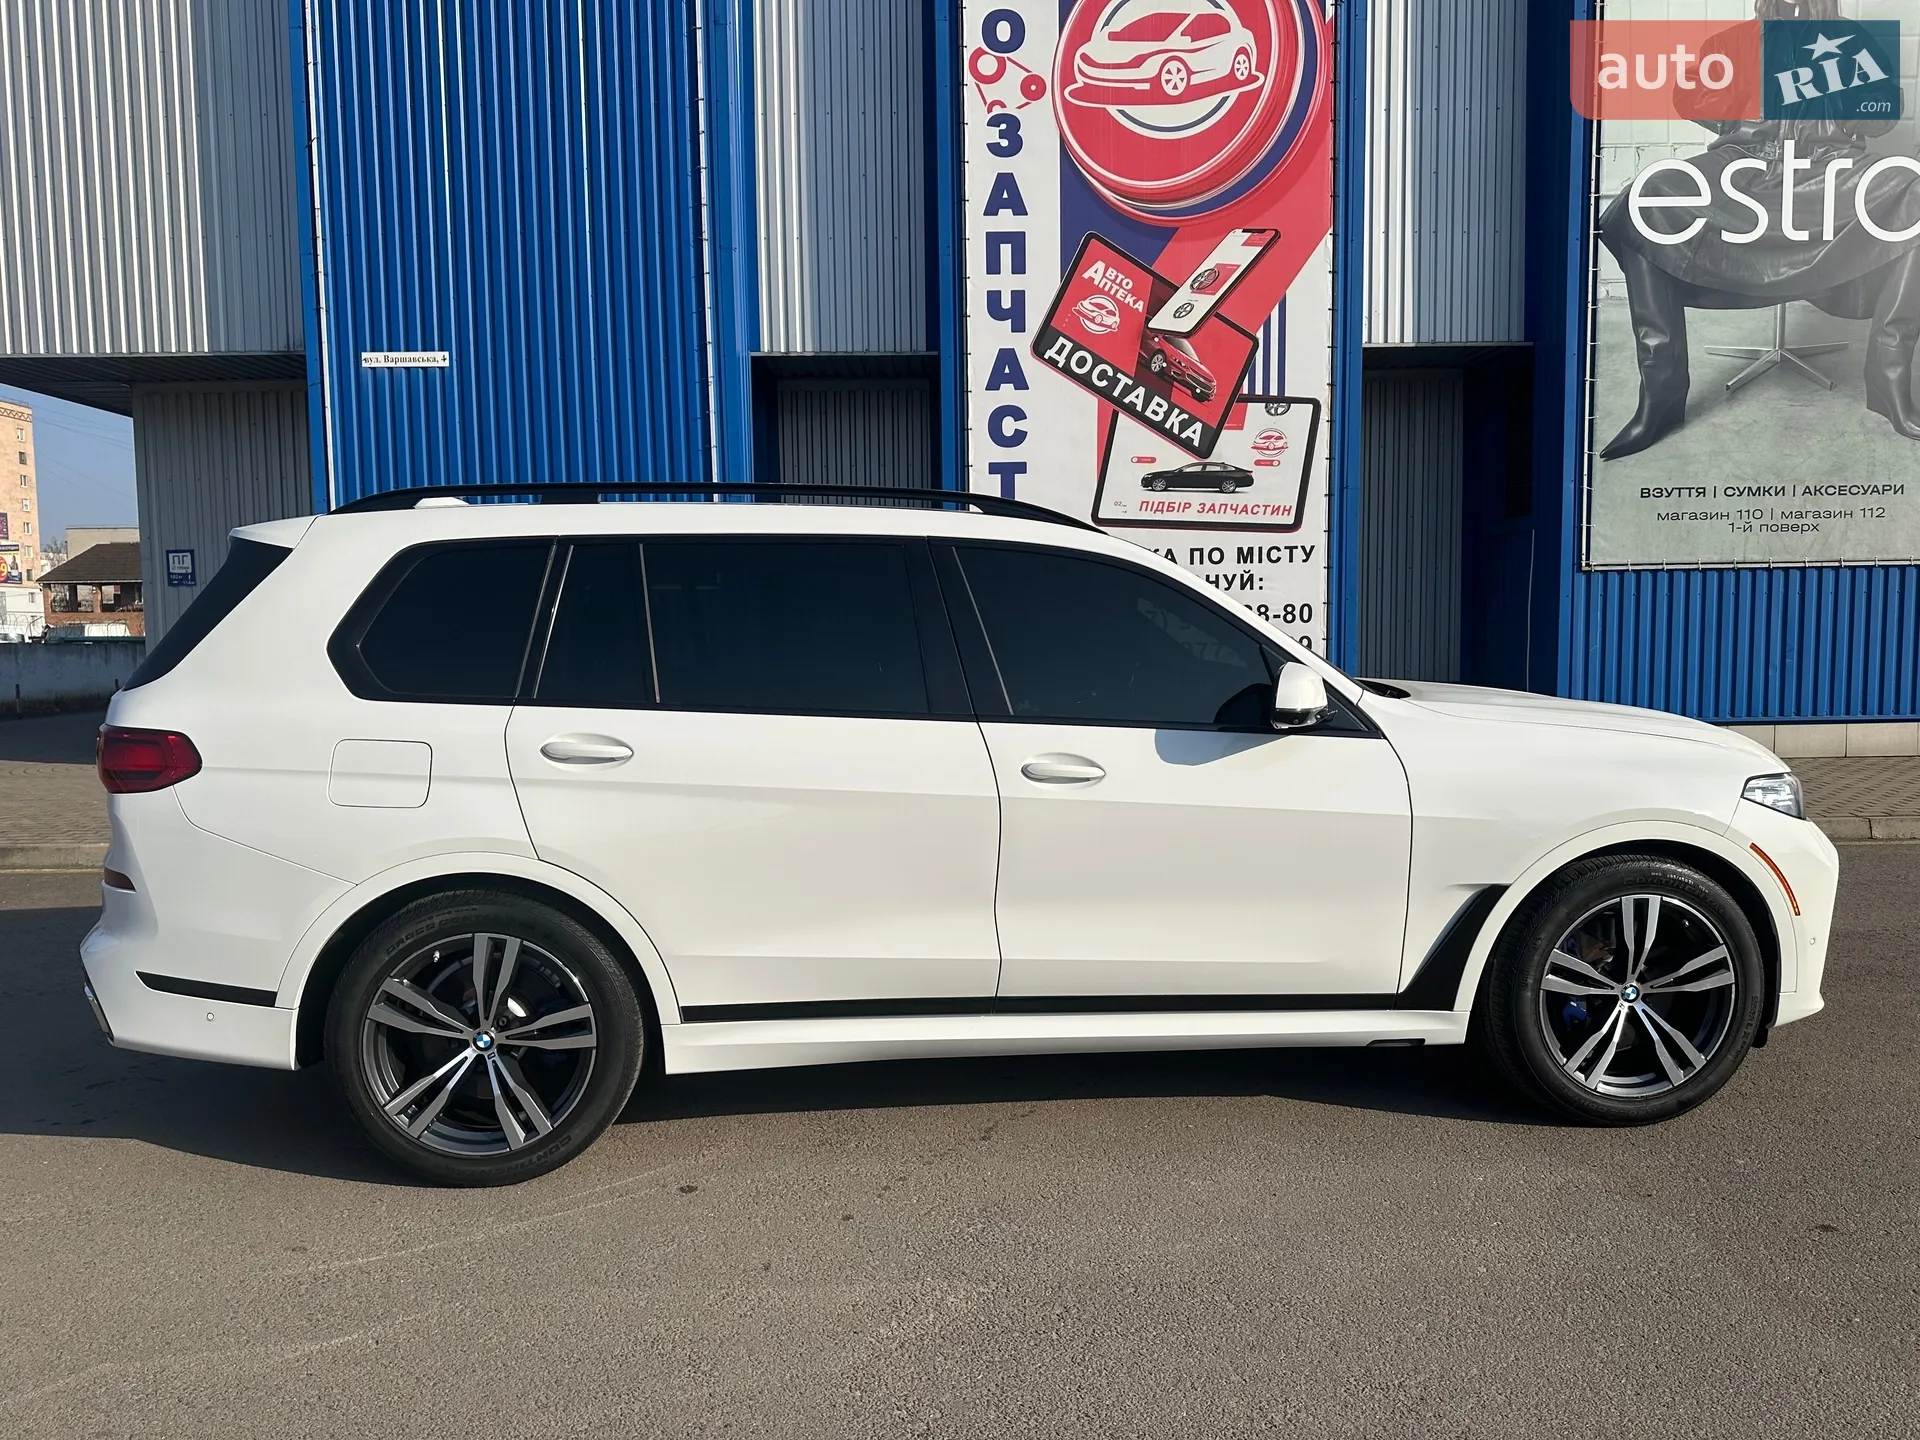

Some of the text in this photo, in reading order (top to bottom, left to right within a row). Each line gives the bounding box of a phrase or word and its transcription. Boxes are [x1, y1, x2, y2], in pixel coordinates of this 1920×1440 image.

[1628, 139, 1920, 246] estro
[383, 354, 439, 365] Варшавська,
[1043, 336, 1203, 447] ДОСТАВКА
[1639, 484, 1905, 499] ВЗУТТЯ СУМКИ АКСЕСУАРИ
[1139, 500, 1293, 517] ПІДБІР ЗАПЧАСТИН
[1656, 507, 1886, 522] магазин 110 магазин 112
[1728, 520, 1820, 535] 1-й поверх
[172, 554, 189, 565] ПГ
[1189, 547, 1225, 566] ПО
[1236, 545, 1316, 565] МІСТУ
[1243, 603, 1313, 625] 8-80
